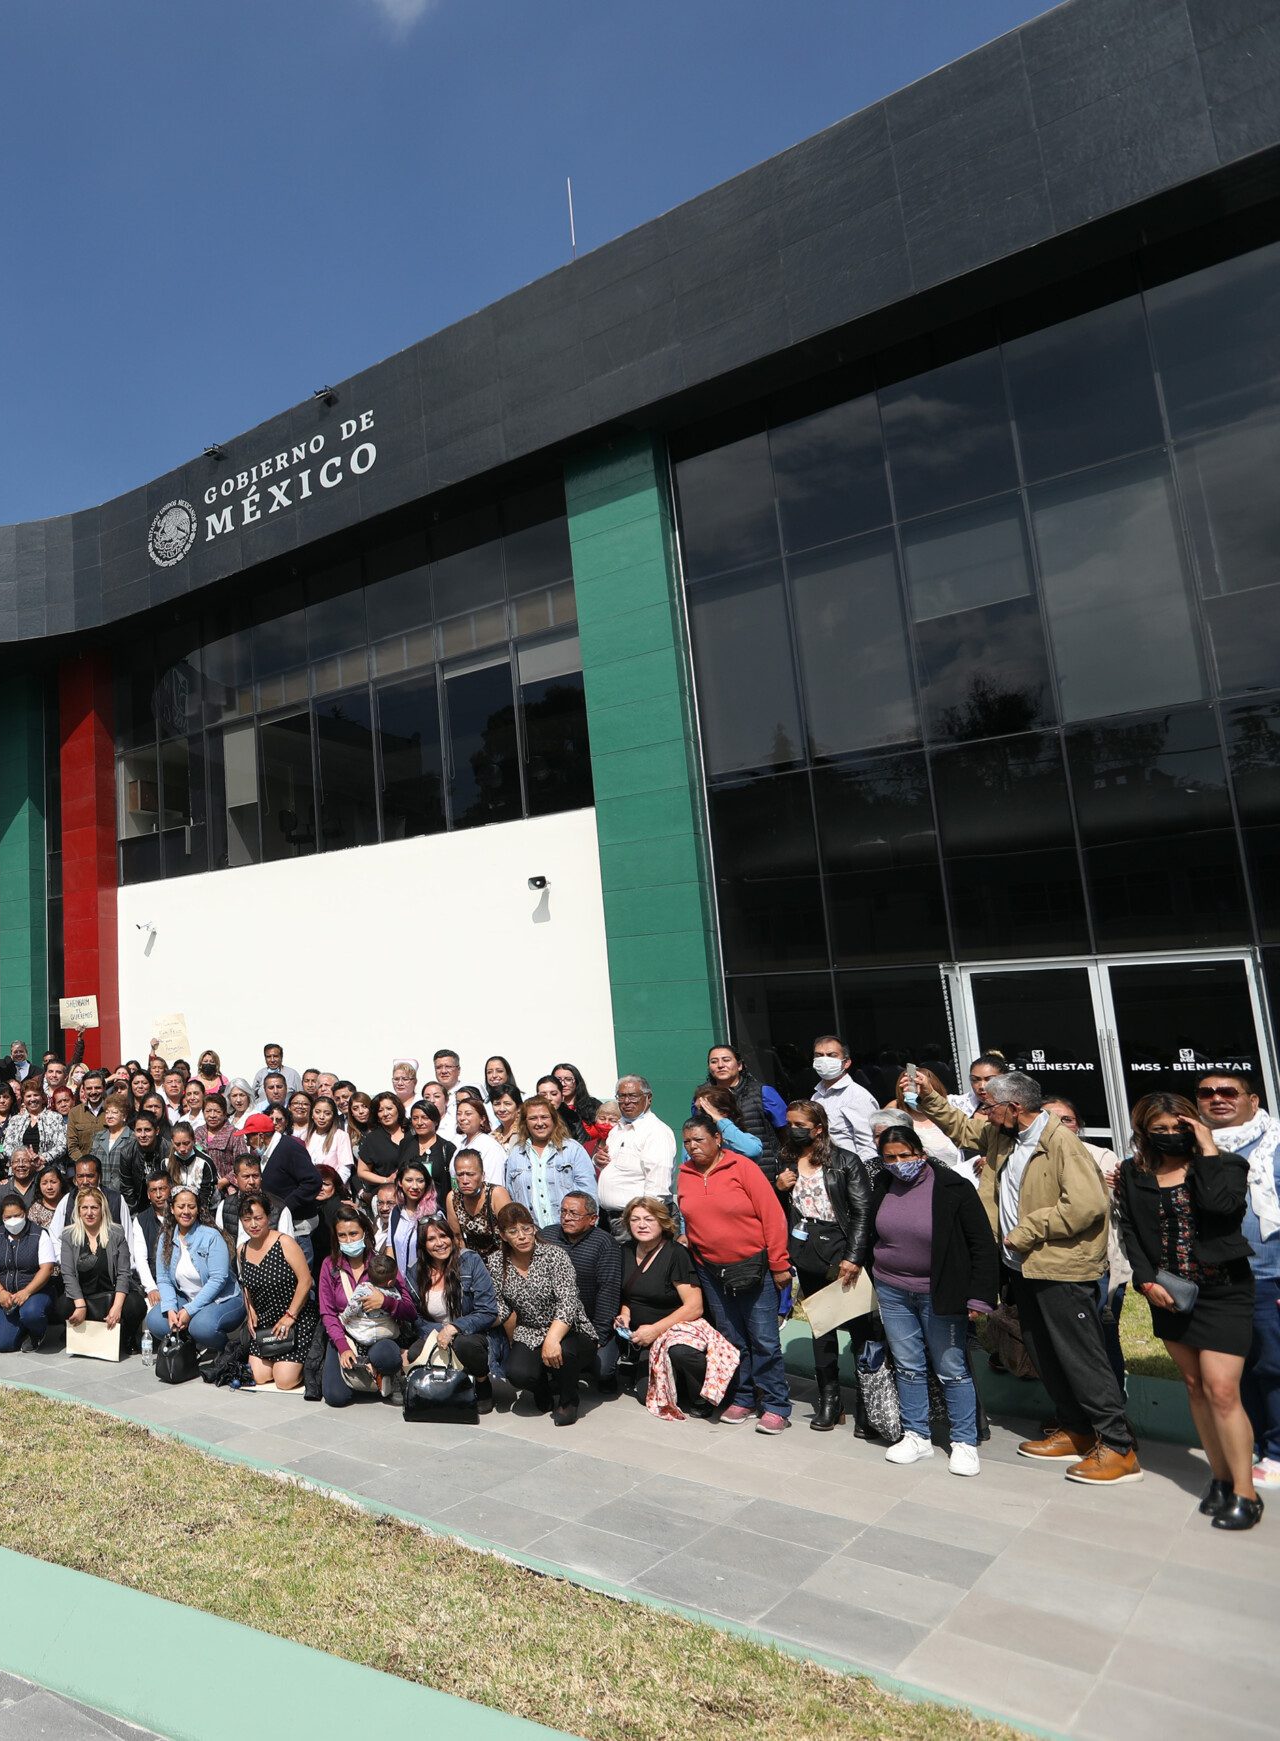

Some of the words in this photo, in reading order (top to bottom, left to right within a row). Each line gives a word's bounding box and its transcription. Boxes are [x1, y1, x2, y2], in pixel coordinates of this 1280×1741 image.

[204, 435, 325, 505] GOBIERNO
[340, 410, 375, 441] DE
[205, 442, 377, 542] MÉXICO
[1025, 1063, 1094, 1071] BIENESTAR
[1131, 1063, 1162, 1071] IMSS
[1173, 1062, 1252, 1071] BIENESTAR
